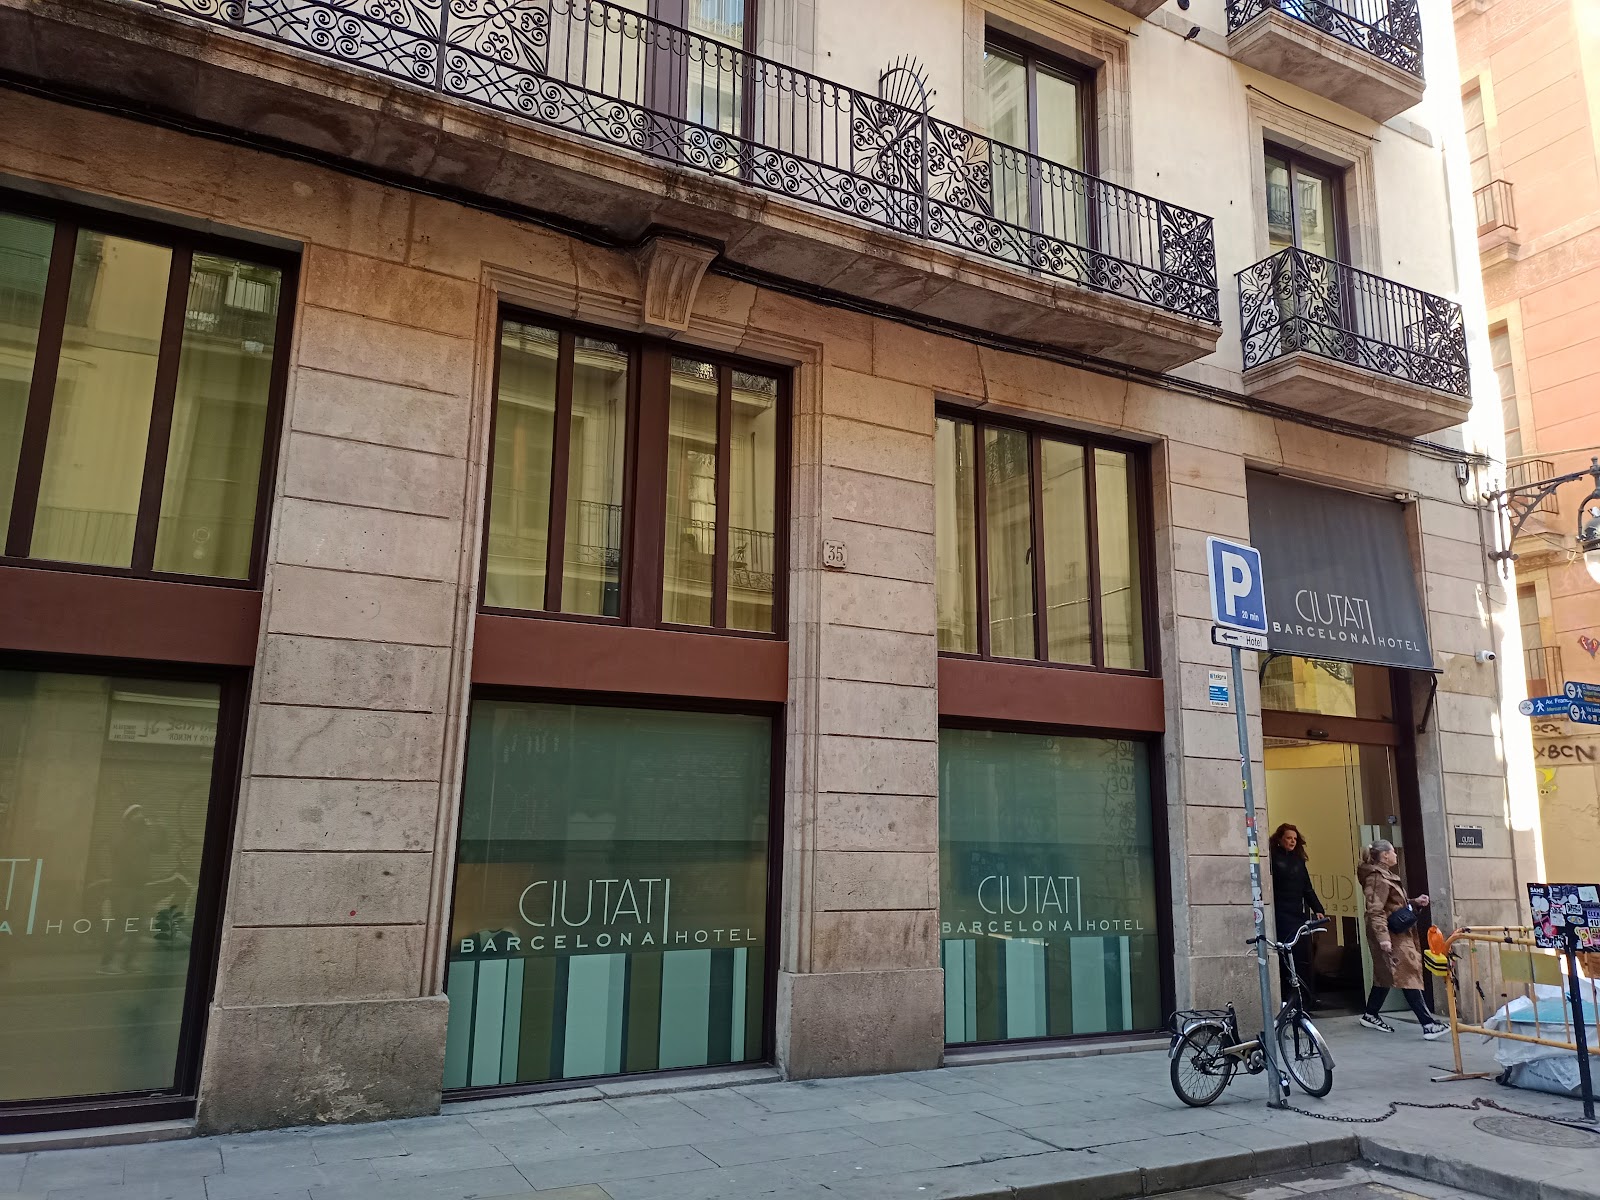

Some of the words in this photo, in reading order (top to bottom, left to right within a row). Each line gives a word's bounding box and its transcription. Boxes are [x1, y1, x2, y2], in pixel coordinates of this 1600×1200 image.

[828, 545, 844, 562] 35
[1221, 550, 1252, 616] P
[1242, 610, 1248, 620] 20
[1250, 612, 1259, 622] min
[1246, 635, 1262, 648] Hotel
[1272, 621, 1369, 645] BARCELONA
[1378, 636, 1420, 652] HOTEL
[45, 917, 162, 935] HOTEL
[942, 920, 1073, 934] BARCELONA
[1086, 919, 1144, 931] HOTEL
[460, 931, 655, 953] BARCELONA
[675, 926, 757, 944] HOTEL
